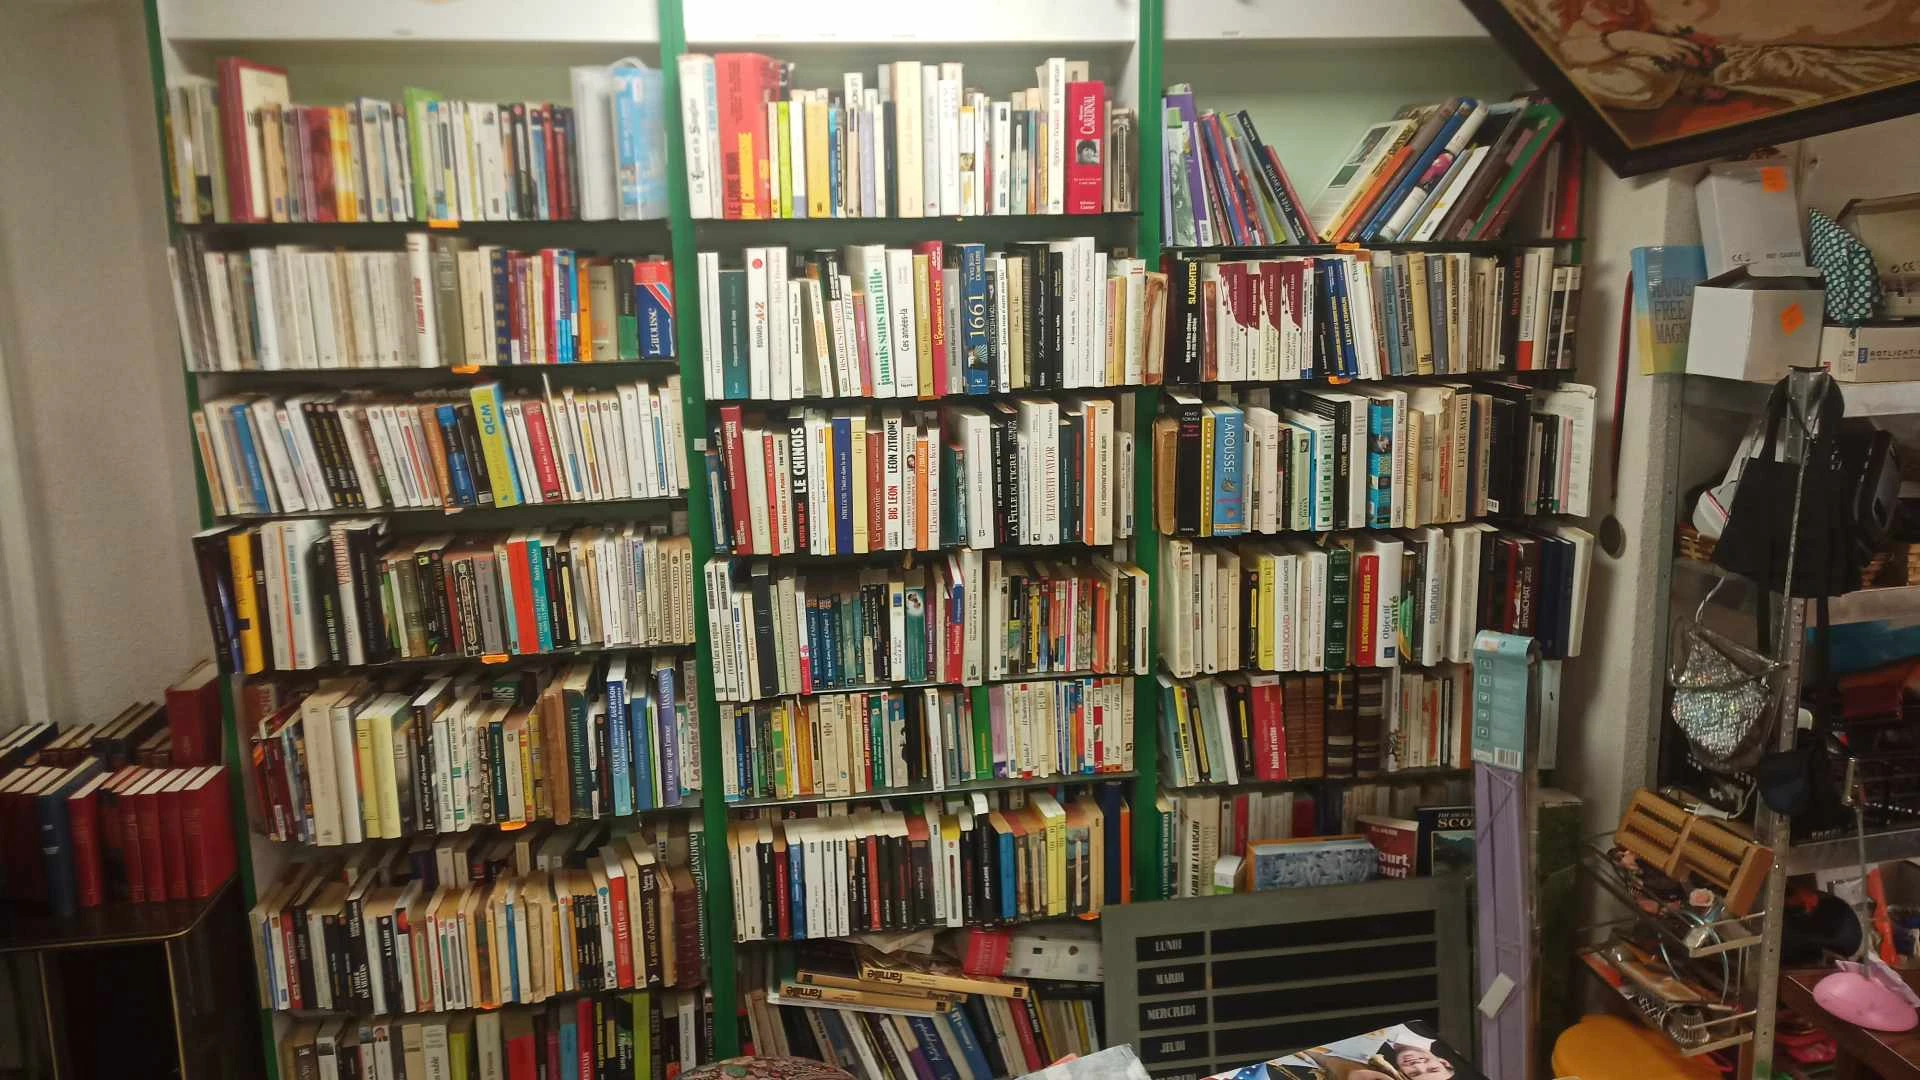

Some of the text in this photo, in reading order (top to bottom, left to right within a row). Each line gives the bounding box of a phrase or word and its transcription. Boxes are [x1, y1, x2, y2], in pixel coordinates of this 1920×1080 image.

[1079, 94, 1096, 135] CARDINAL
[1187, 262, 1198, 305] SLAUGHTER
[647, 306, 661, 355] Larousse
[869, 268, 893, 386] jamais sans ma fille
[897, 308, 910, 352] Ces années-là
[968, 293, 985, 339] 1661
[480, 403, 496, 435] QCM
[790, 427, 806, 494] LE CHINOIS
[887, 419, 898, 474] LEON ZITRONE
[1222, 416, 1236, 473] LAROUSSE
[1457, 456, 1466, 469] LE
[1007, 453, 1019, 537] LA FILLE DU TIGRE
[1045, 446, 1056, 522] ELIZABETH TAYLOR
[888, 485, 898, 520] BIG LEON
[874, 532, 881, 543] La
[1382, 604, 1392, 640] Objectif
[1389, 595, 1400, 633] santé
[609, 685, 618, 718] GUÉRISON
[1437, 817, 1473, 829] SCO
[1377, 852, 1411, 869] ourt,
[1154, 938, 1183, 953] LUNDI
[785, 985, 823, 999] famille
[867, 968, 904, 985] famille
[1155, 971, 1185, 985] MARDI
[1146, 1003, 1197, 1022] MERCREDI
[1159, 1038, 1187, 1054] JEUDI
